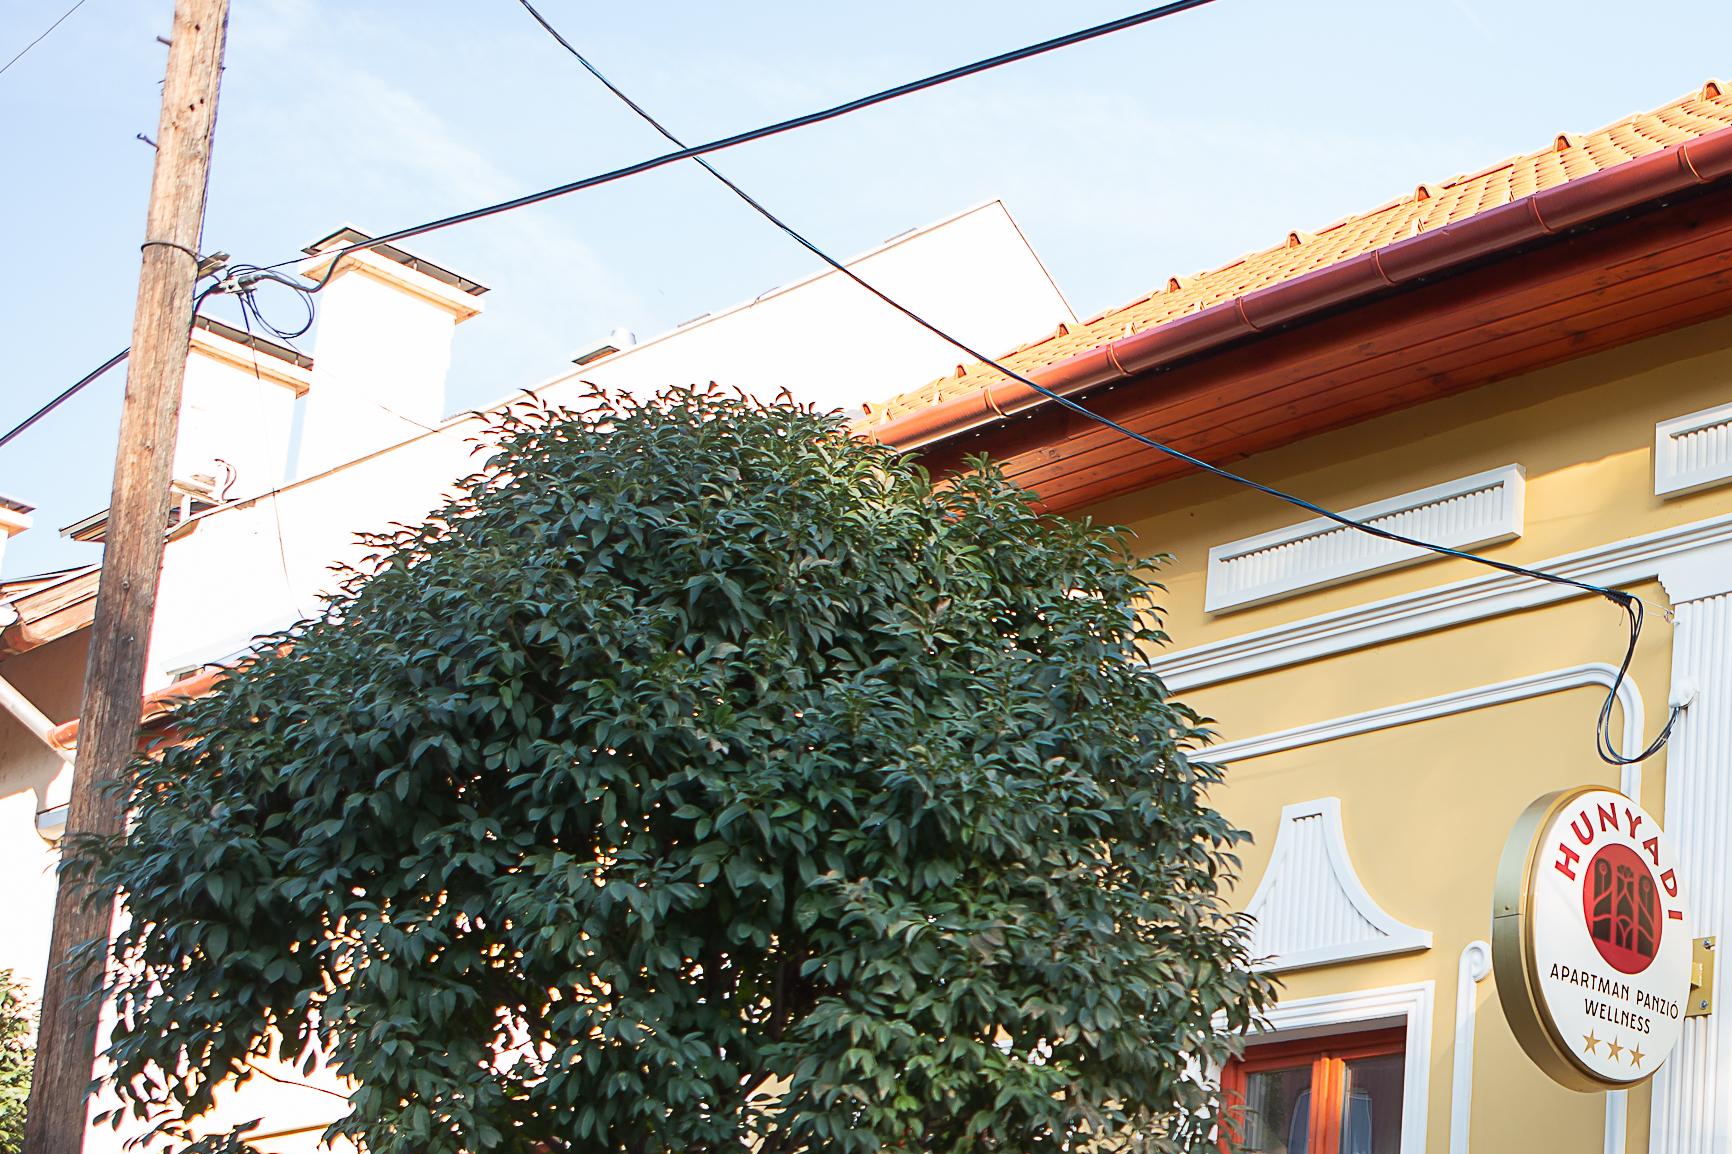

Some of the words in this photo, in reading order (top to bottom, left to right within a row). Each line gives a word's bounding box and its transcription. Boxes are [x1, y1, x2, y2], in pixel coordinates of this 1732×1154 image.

[1554, 802, 1683, 921] HUNYADI
[1550, 963, 1630, 1001] APARTMAN
[1636, 989, 1680, 1020] PANZIÓ
[1584, 998, 1651, 1035] WELLNESS
